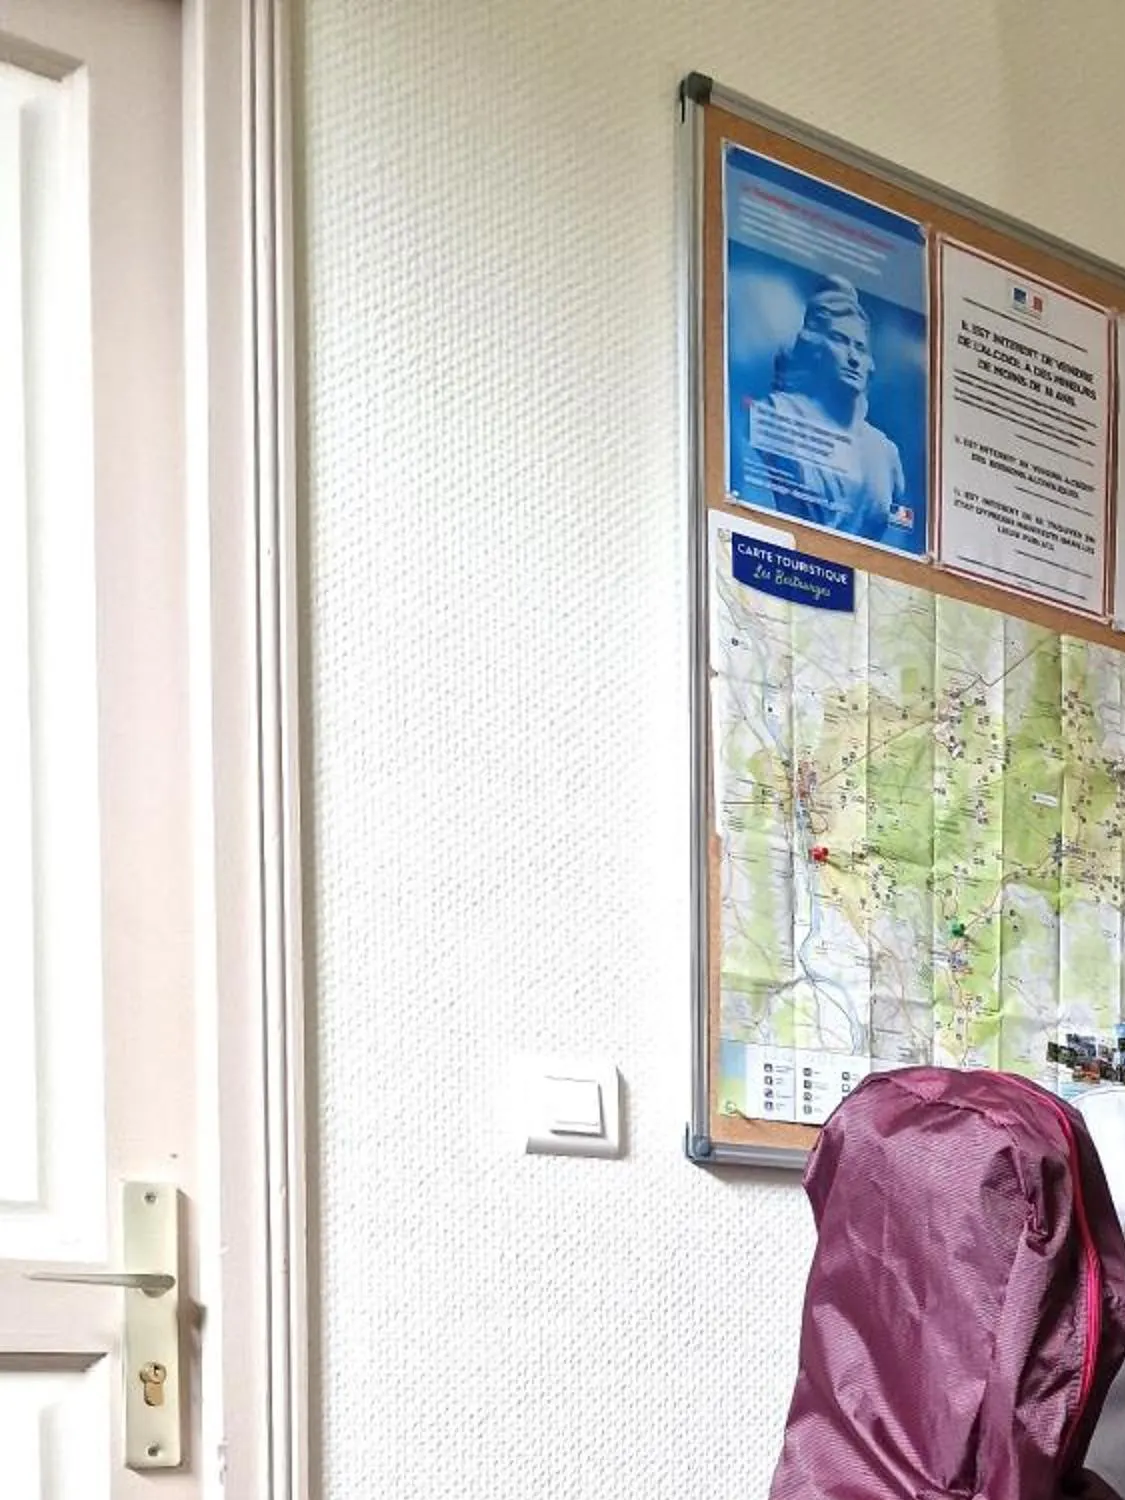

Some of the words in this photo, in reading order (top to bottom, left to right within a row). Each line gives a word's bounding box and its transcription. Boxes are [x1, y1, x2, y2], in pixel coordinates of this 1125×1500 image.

[737, 543, 773, 563] CARTE
[776, 554, 849, 585] TOURISTIQUE
[753, 564, 771, 580] Les
